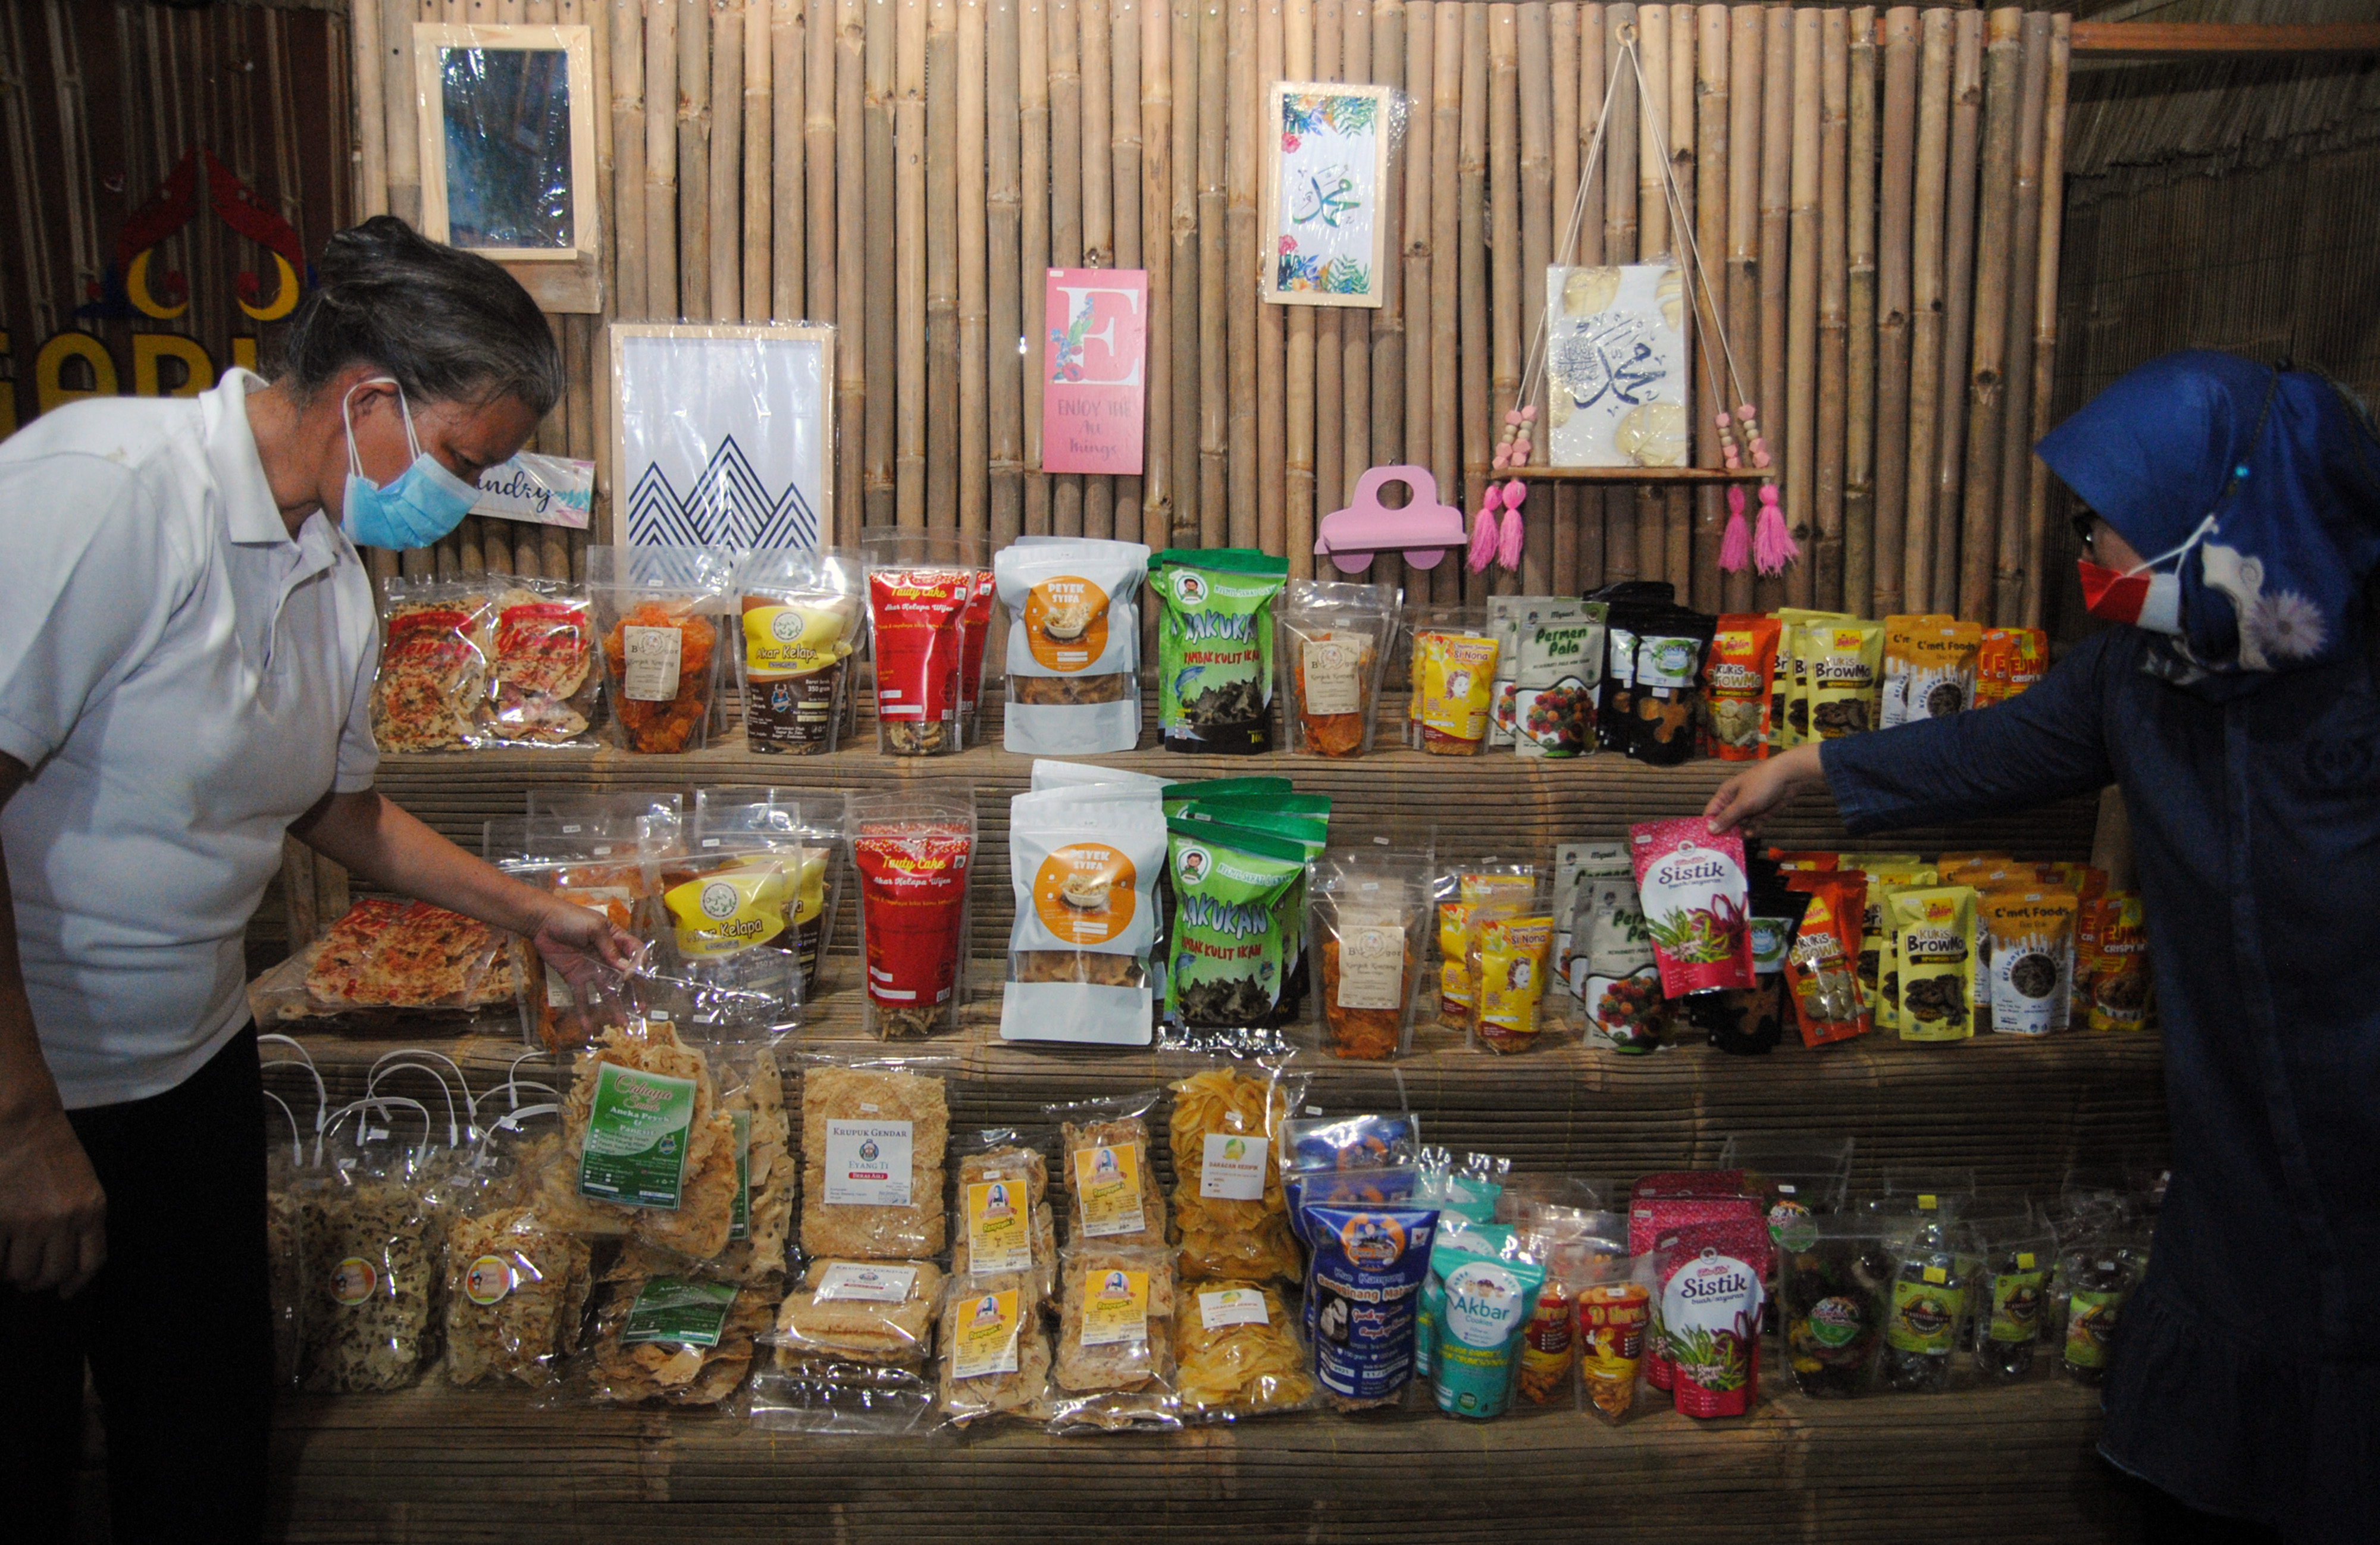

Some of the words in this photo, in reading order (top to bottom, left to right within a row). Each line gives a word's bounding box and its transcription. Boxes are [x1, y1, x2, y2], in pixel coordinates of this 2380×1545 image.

[1058, 399, 1101, 417] ENJOY
[477, 471, 552, 513] undry
[1048, 583, 1085, 593] PEYEK
[1052, 594, 1080, 603] SYIFA
[1535, 628, 1587, 644] Permen
[1548, 639, 1579, 656] Pala
[1948, 642, 1976, 651] Foods
[756, 647, 779, 659] Akar
[782, 643, 819, 664] Kelapa
[1215, 652, 1242, 665] KULIT
[1454, 651, 1462, 659] Si
[1464, 651, 1488, 660] Nona
[1069, 849, 1110, 861] PEYEK
[917, 857, 945, 869] Cake
[1073, 860, 1103, 870] SYIFA
[1658, 861, 1726, 885] Sistik
[895, 878, 927, 888] Kelapa
[929, 878, 951, 887] Wijen
[2033, 907, 2069, 917] Foods
[719, 919, 763, 939] Kelapa
[1512, 935, 1519, 945] Si
[1522, 935, 1546, 944] Nona
[1205, 944, 1234, 961] KULIT
[1238, 944, 1262, 959] IKAN
[2104, 944, 2135, 952] CRISPY
[615, 1074, 672, 1100] Cahaya
[610, 1106, 640, 1119] Aneka
[642, 1112, 669, 1123] Peyek
[834, 1127, 869, 1136] KRUPUK
[871, 1129, 907, 1137] GENDAR
[1317, 1273, 1380, 1304] Rengginang
[1680, 1273, 1748, 1299] Sistik
[1692, 1293, 1744, 1305] buah/sayuran
[1455, 1296, 1510, 1321] Akbar
